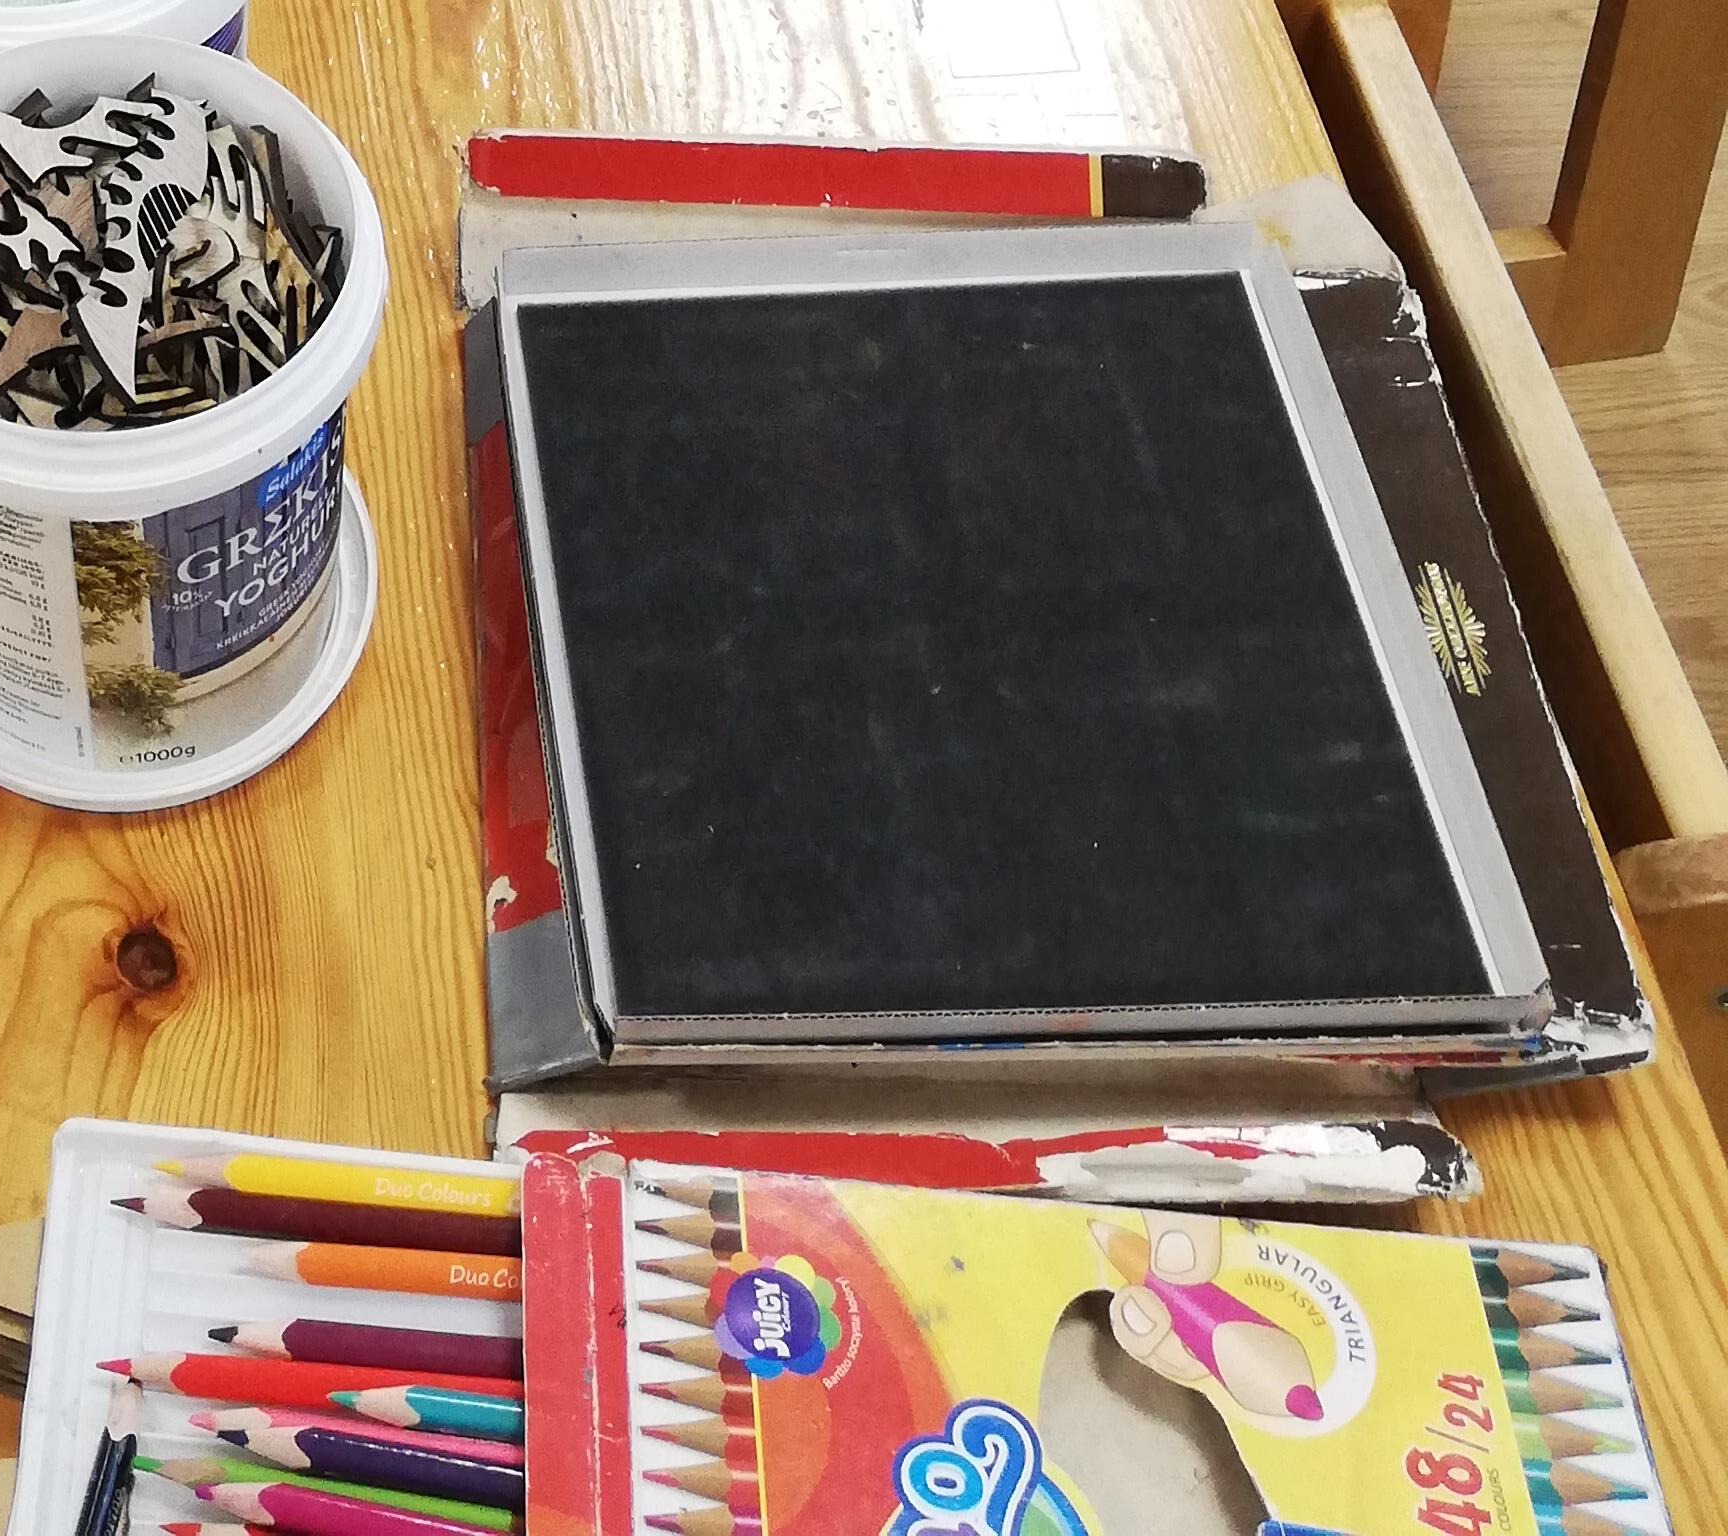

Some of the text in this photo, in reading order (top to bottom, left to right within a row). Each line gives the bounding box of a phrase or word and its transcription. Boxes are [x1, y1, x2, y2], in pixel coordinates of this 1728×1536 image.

[374, 1177, 491, 1208] Duo Colours
[449, 1264, 489, 1286] Duo
[1243, 1272, 1327, 1328] EASY GRIP
[1257, 1243, 1366, 1364] TRIANGULAR
[1486, 1467, 1512, 1532] COLOURS
